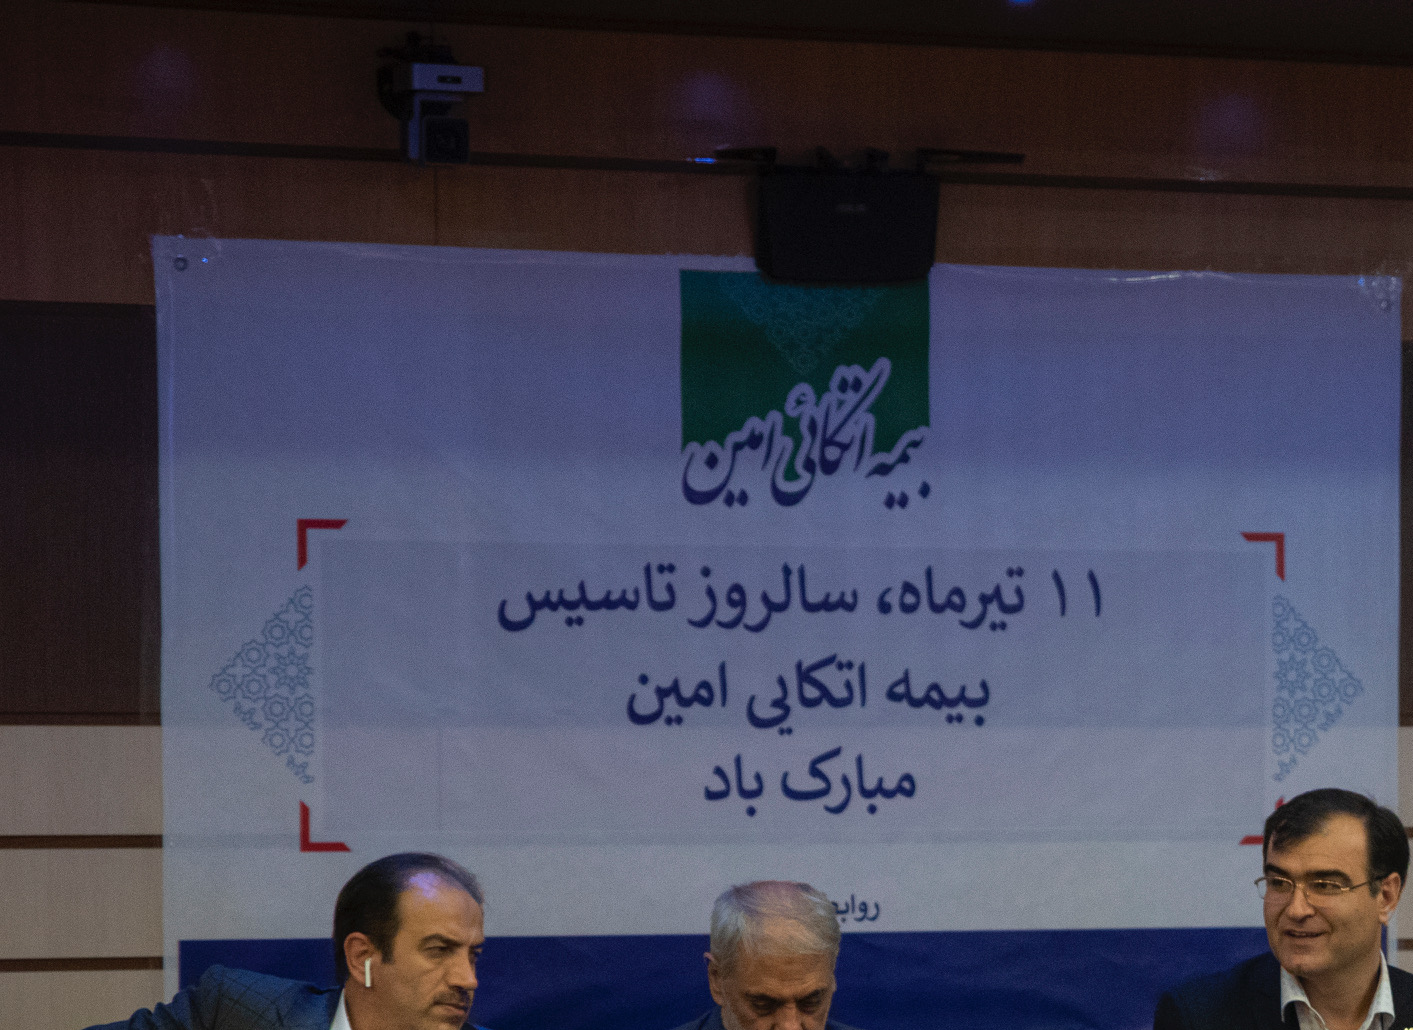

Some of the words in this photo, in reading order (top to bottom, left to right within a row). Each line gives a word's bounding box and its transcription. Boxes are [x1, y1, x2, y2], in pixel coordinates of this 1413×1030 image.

[681, 419, 777, 508] امین
[497, 562, 677, 633] تاسیس
[687, 562, 859, 634] سالروز
[876, 565, 1025, 632] تیرماه،
[1052, 569, 1103, 617] ۱۱
[626, 661, 728, 727] امین
[746, 653, 867, 736] اتکایی
[885, 668, 991, 727] بیمه
[703, 753, 765, 818] باد
[780, 746, 917, 815] مبارک
